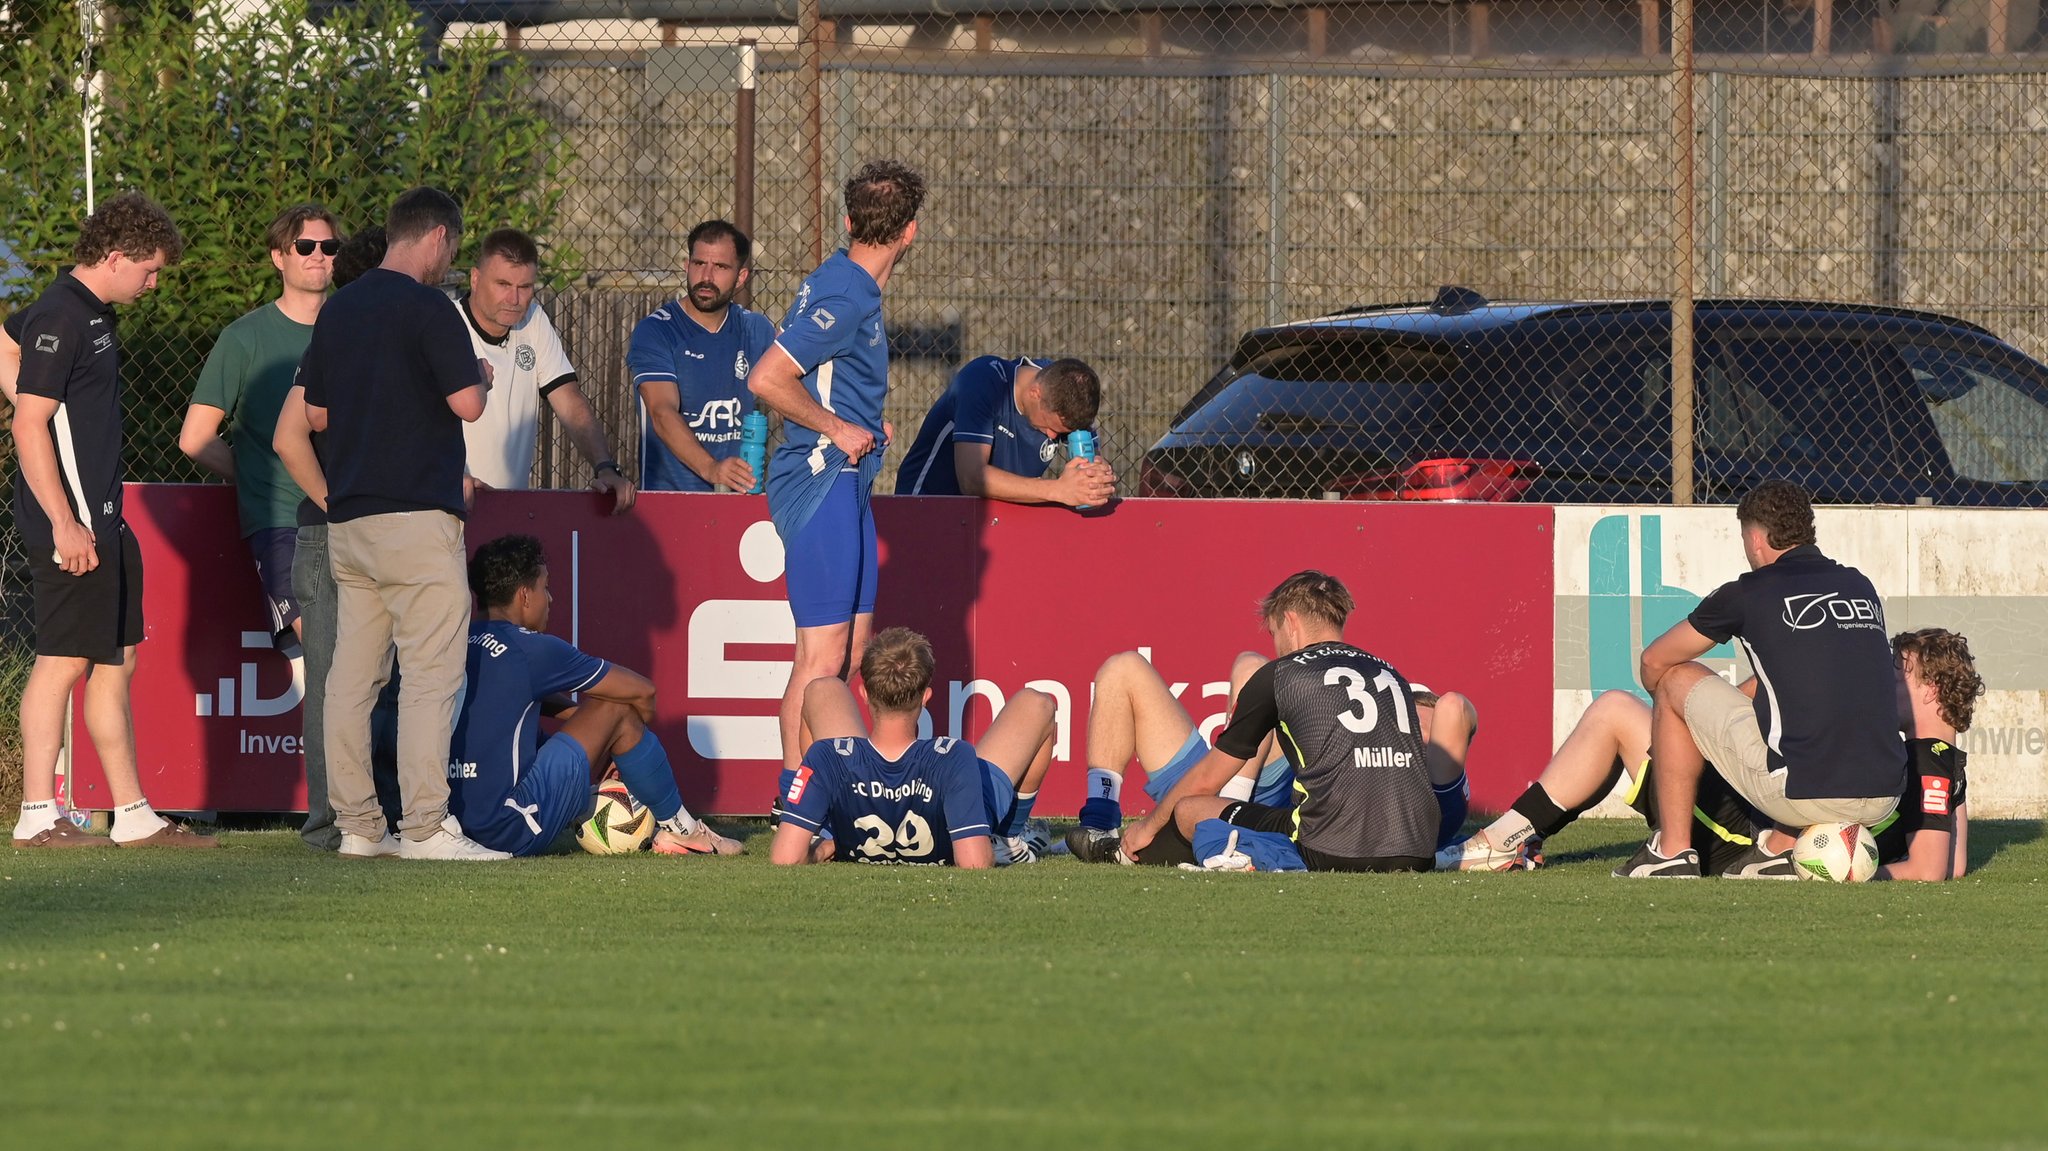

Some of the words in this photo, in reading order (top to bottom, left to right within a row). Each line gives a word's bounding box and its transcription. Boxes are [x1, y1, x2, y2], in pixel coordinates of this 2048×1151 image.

[103, 501, 114, 515] AB
[1323, 666, 1411, 735] 31
[447, 758, 478, 779] chez
[1354, 746, 1413, 769] Müller
[124, 801, 148, 813] adida
[853, 809, 935, 858] 29
